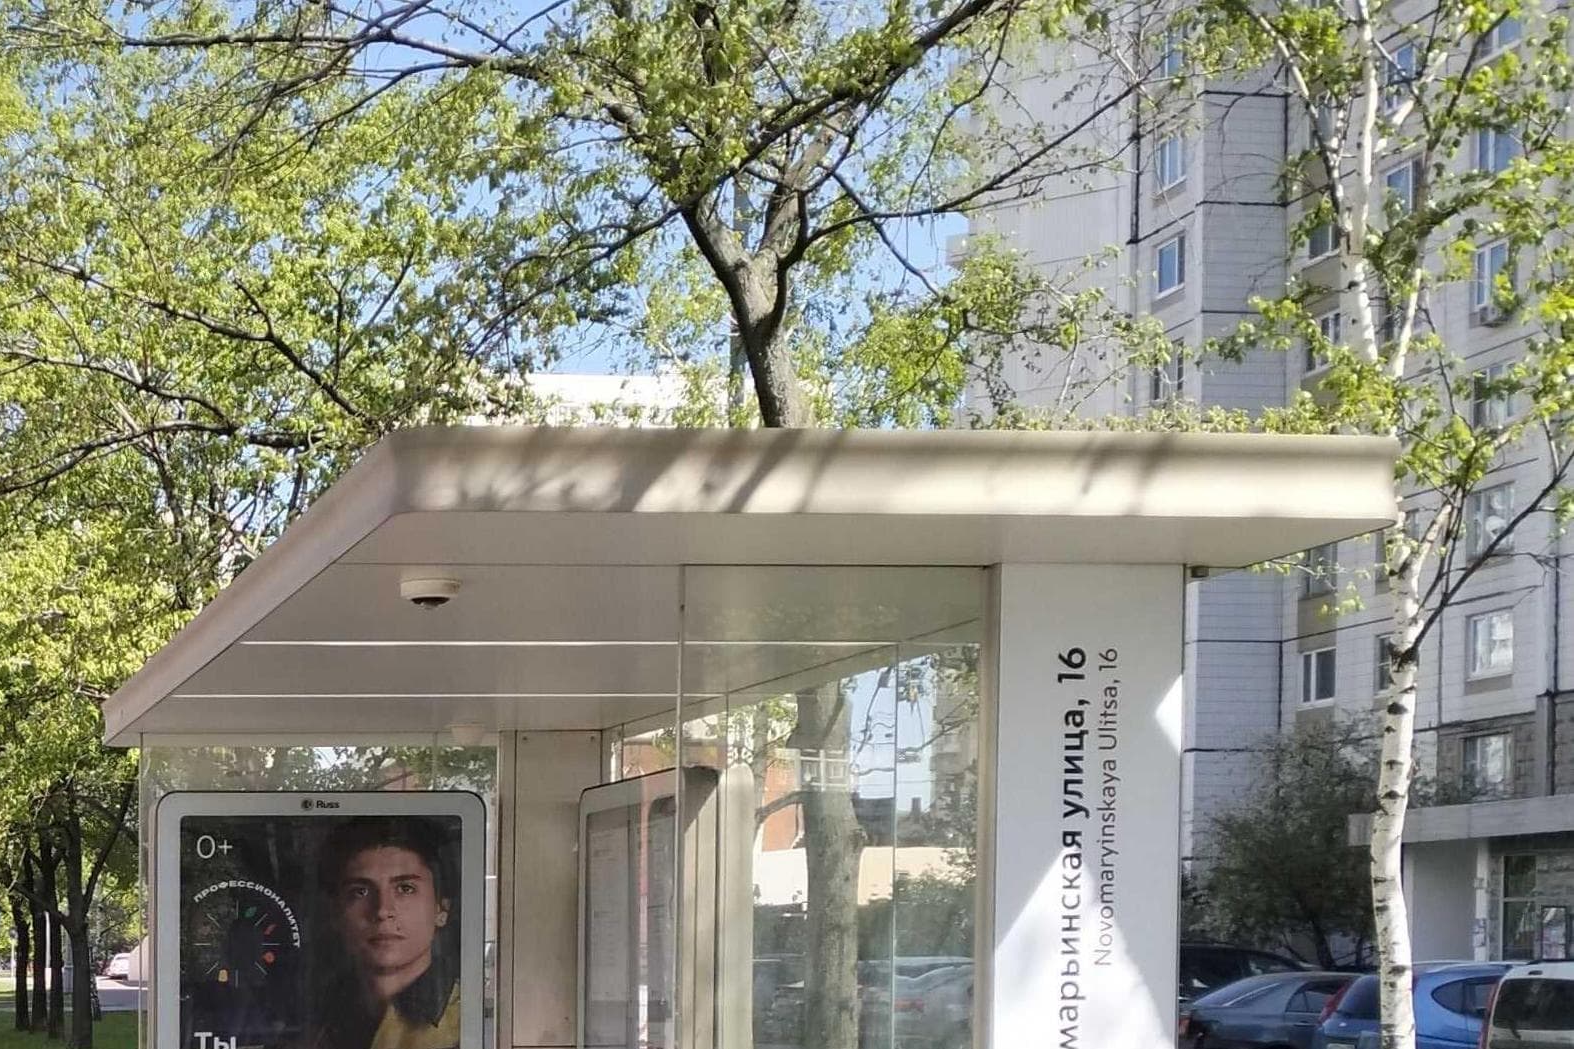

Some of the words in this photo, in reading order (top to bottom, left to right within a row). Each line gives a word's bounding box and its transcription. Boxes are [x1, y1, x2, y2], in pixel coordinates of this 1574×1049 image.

[1057, 646, 1087, 684] 16
[1098, 648, 1118, 672] 16
[1097, 679, 1121, 750] Ulitsa,
[1062, 698, 1091, 820] улица,
[196, 834, 233, 860] 0+
[1093, 758, 1121, 966] Novomaryinskaya
[193, 879, 301, 948] ПРОФЕССИОНАЛИТЕТ
